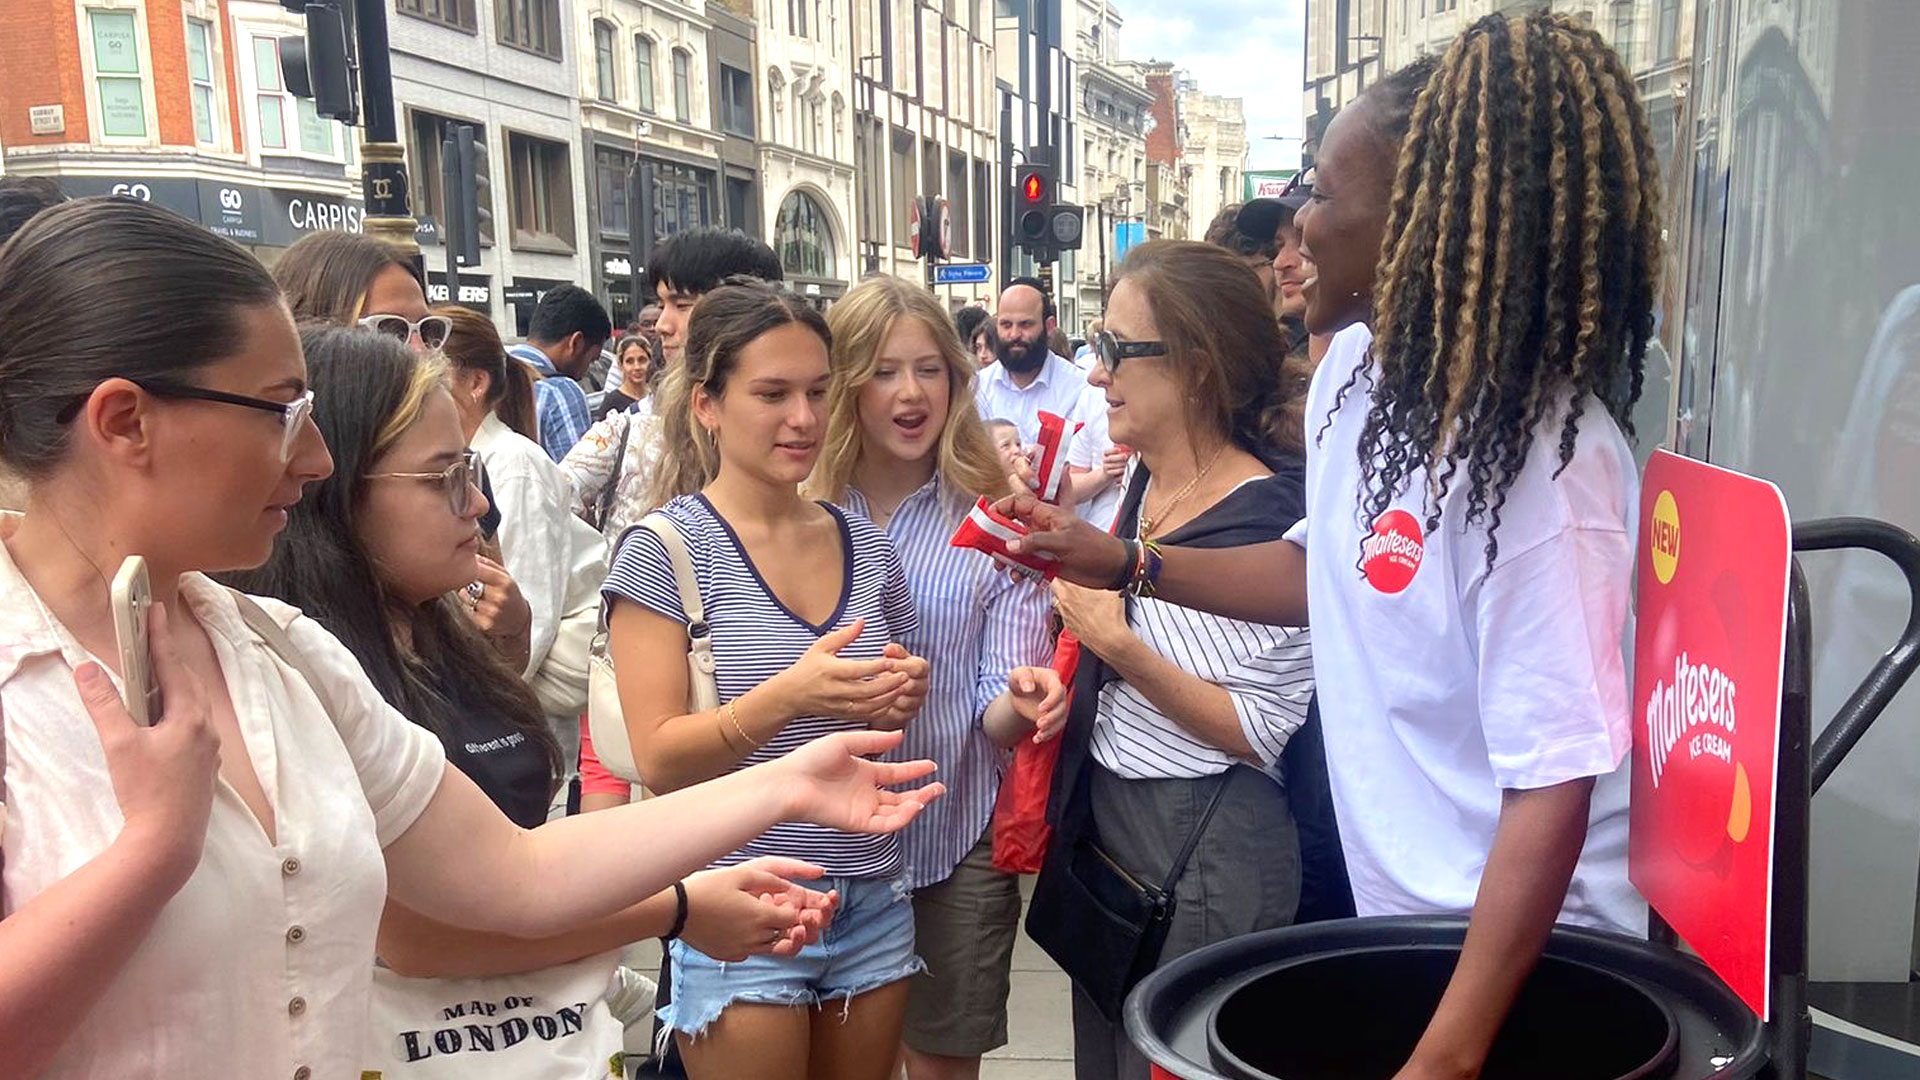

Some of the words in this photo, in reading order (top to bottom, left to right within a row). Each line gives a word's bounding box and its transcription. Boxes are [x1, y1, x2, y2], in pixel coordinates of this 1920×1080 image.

[220, 188, 242, 209] GO
[1364, 528, 1423, 564] Maltesers
[1653, 518, 1679, 557] NEW
[1688, 735, 1702, 760] ICE
[1702, 733, 1731, 764] CREAM
[443, 1000, 497, 1020] MAP
[504, 996, 534, 1010] OF
[399, 1003, 588, 1063] LONDON
